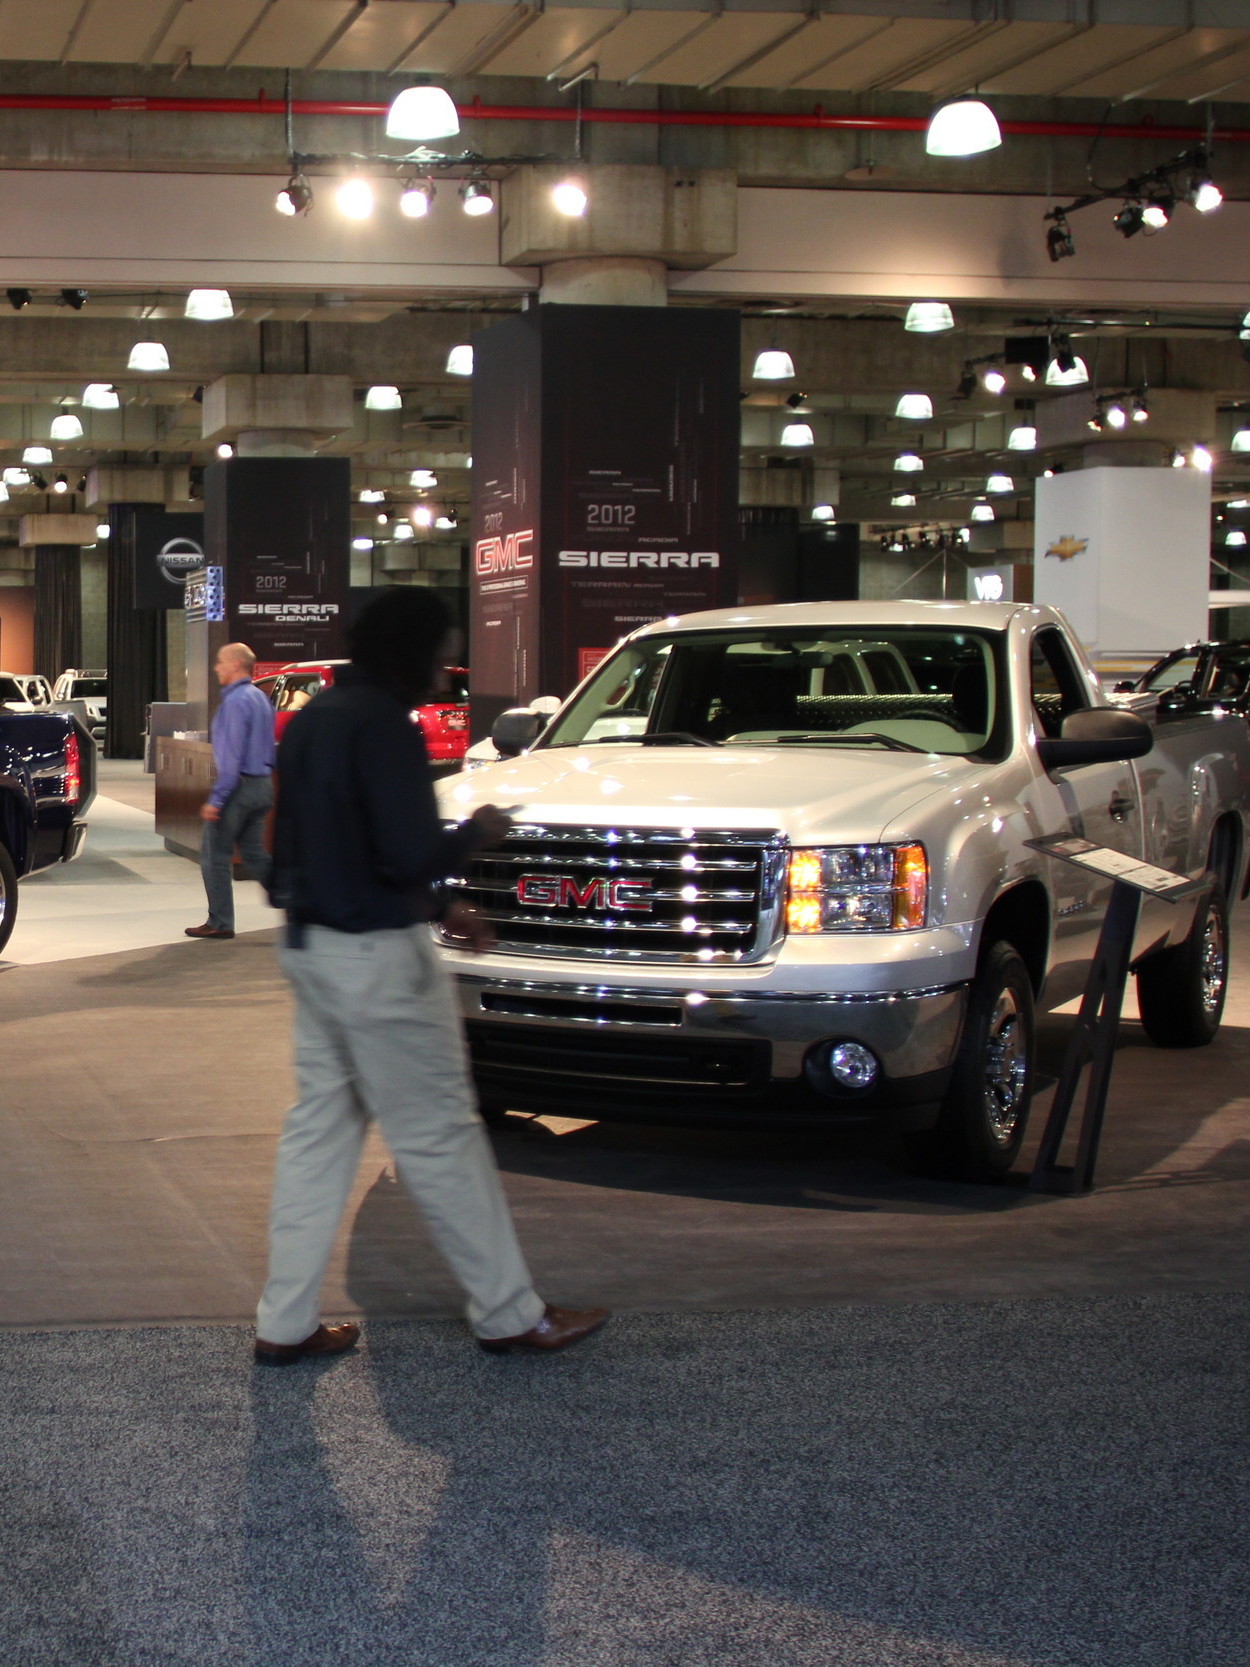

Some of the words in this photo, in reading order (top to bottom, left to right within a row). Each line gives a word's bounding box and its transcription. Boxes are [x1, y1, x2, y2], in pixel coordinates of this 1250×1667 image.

[485, 512, 503, 533] 2012
[587, 504, 635, 524] 2012
[160, 557, 204, 565] NISSAN
[476, 529, 533, 576] GMC
[558, 551, 720, 569] SIERRA
[256, 576, 286, 588] 2012
[238, 603, 339, 615] SIERRA
[516, 873, 654, 913] GMC
